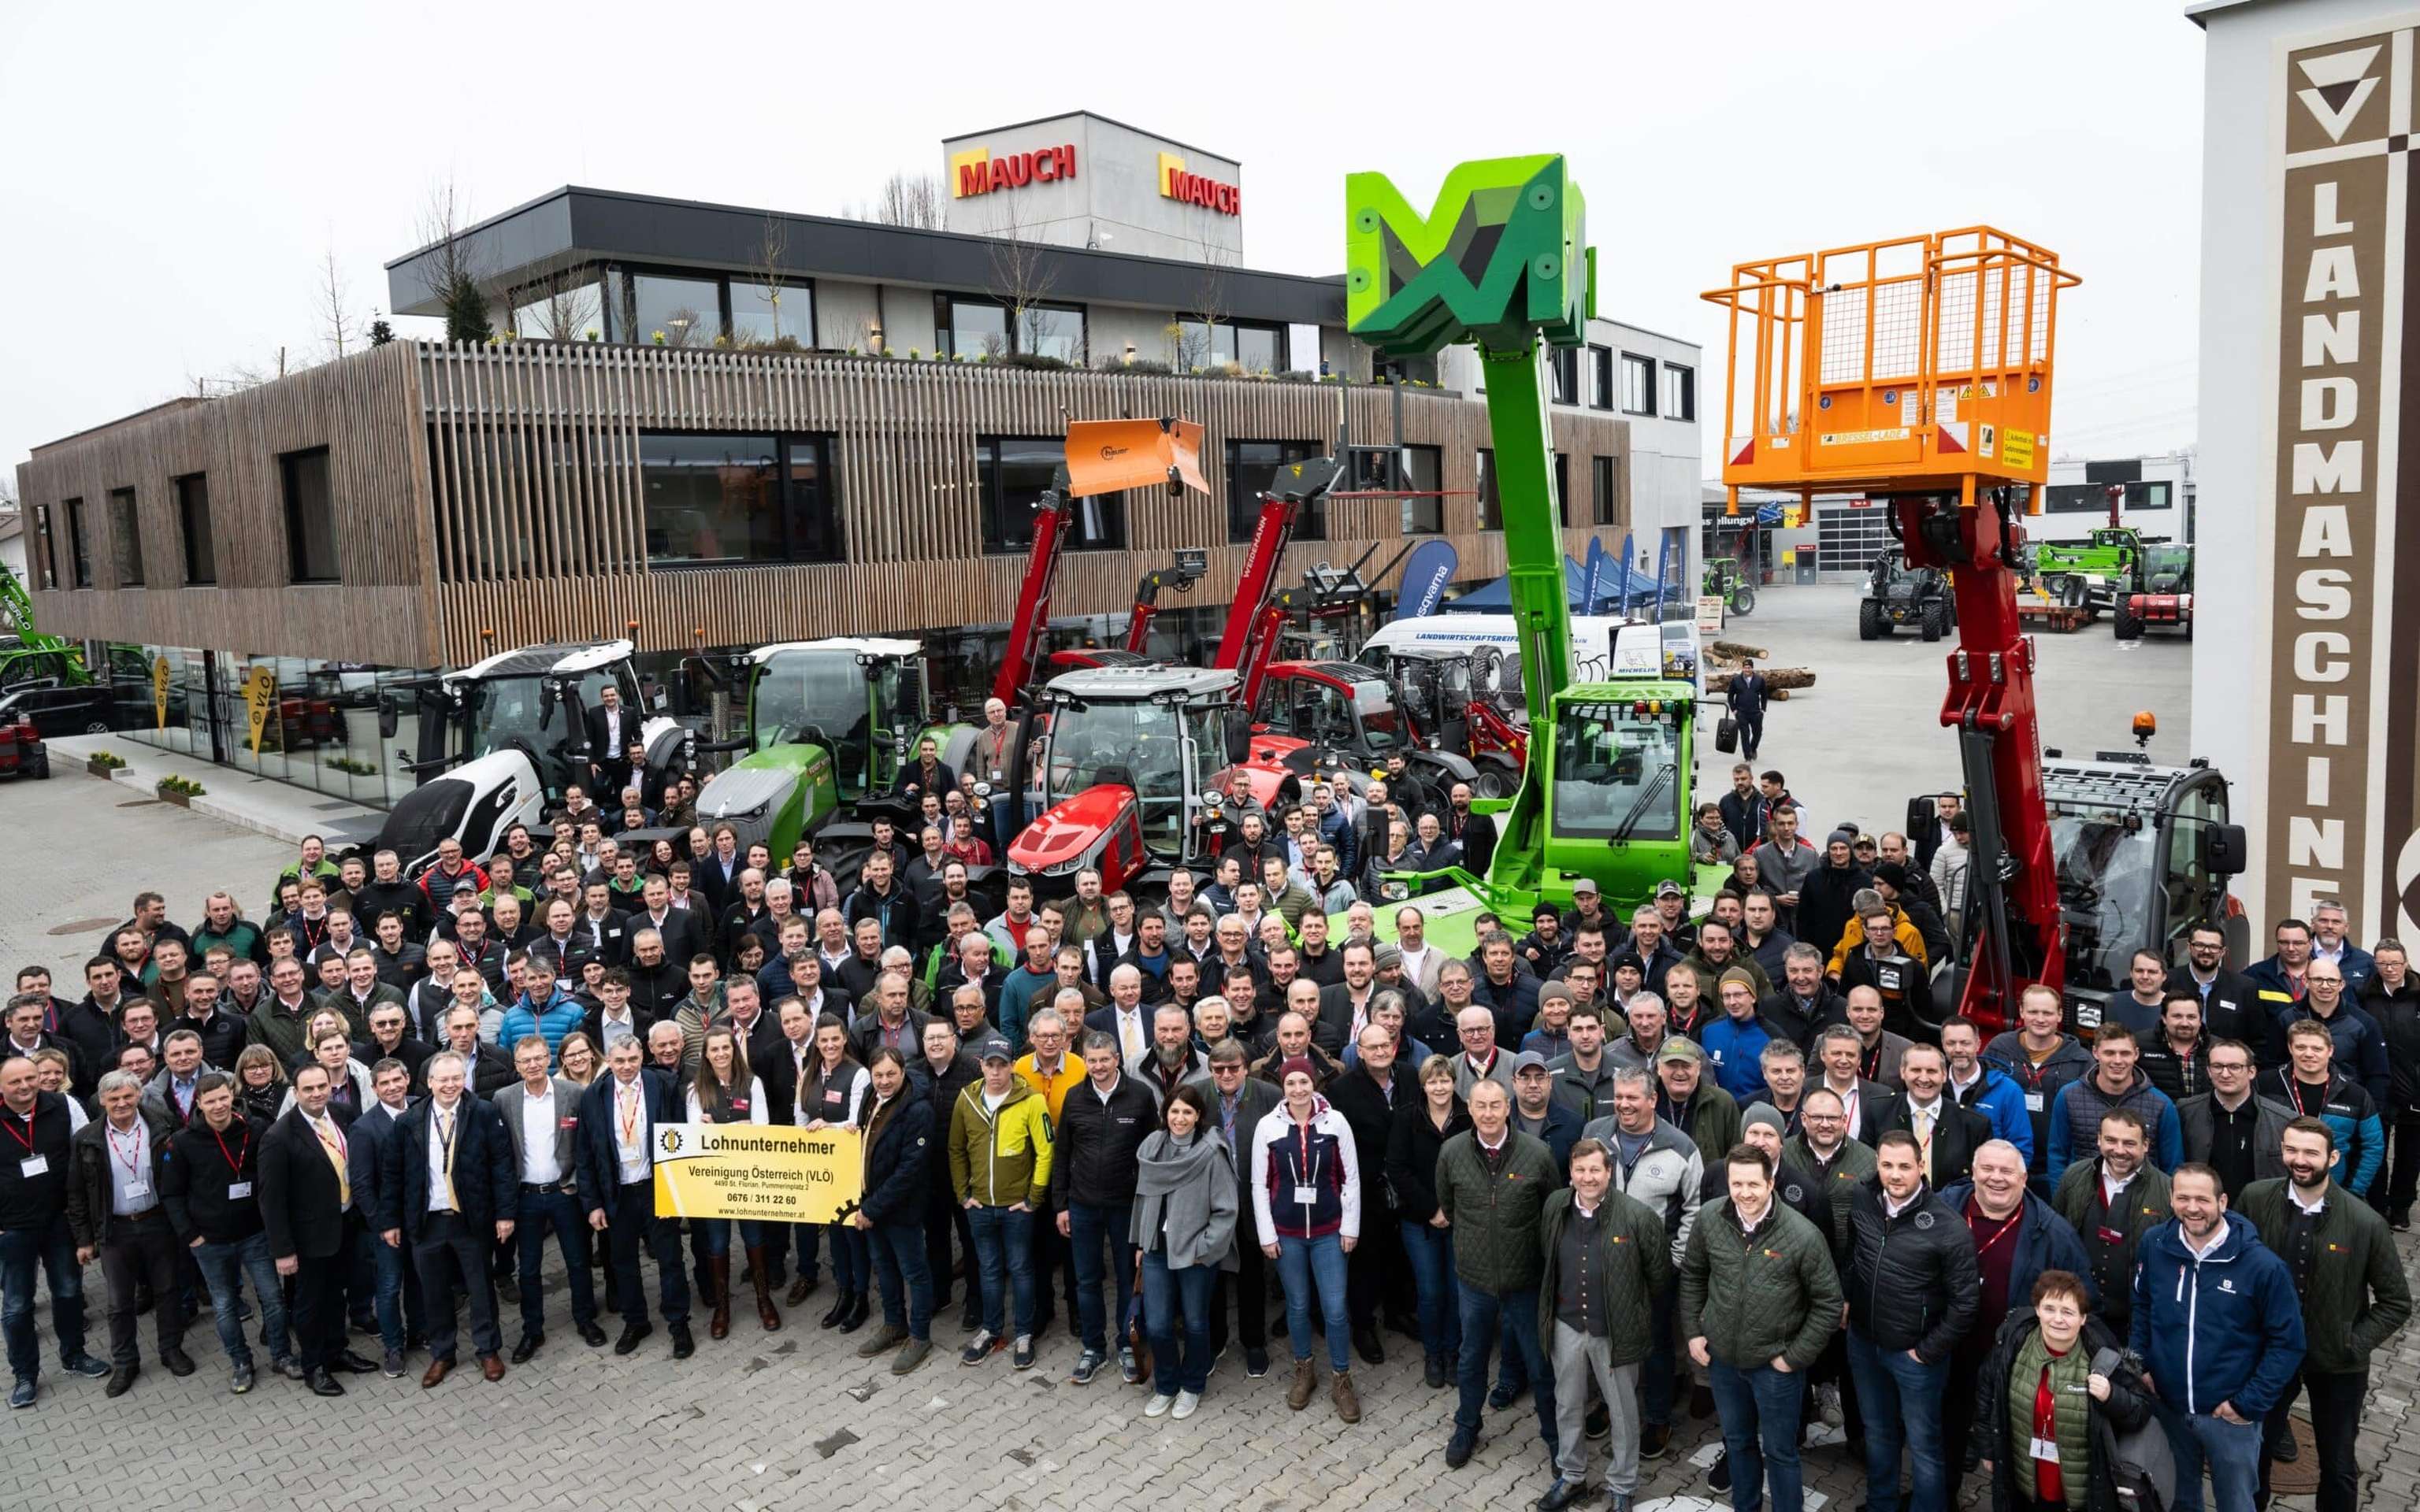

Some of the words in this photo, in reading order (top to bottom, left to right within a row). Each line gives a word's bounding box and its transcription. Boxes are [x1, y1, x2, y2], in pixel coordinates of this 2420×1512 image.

[959, 144, 1076, 197] MAUCH
[1168, 167, 1240, 216] MAUCH
[1243, 515, 1268, 579] WEIDEMANN
[1416, 633, 1520, 642] LANDWIRTSCHAFTSREIFE
[701, 1135, 836, 1155] Lohnunternehmer
[689, 1166, 749, 1181] Vereinigung
[752, 1165, 803, 1181] Österreich
[806, 1169, 833, 1184] (VLÖ)
[727, 1193, 748, 1203] 0676
[755, 1194, 770, 1203] 311
[773, 1195, 783, 1204] 22
[785, 1195, 796, 1205] 60
[718, 1207, 806, 1219] www.lohnunternehmer.at
